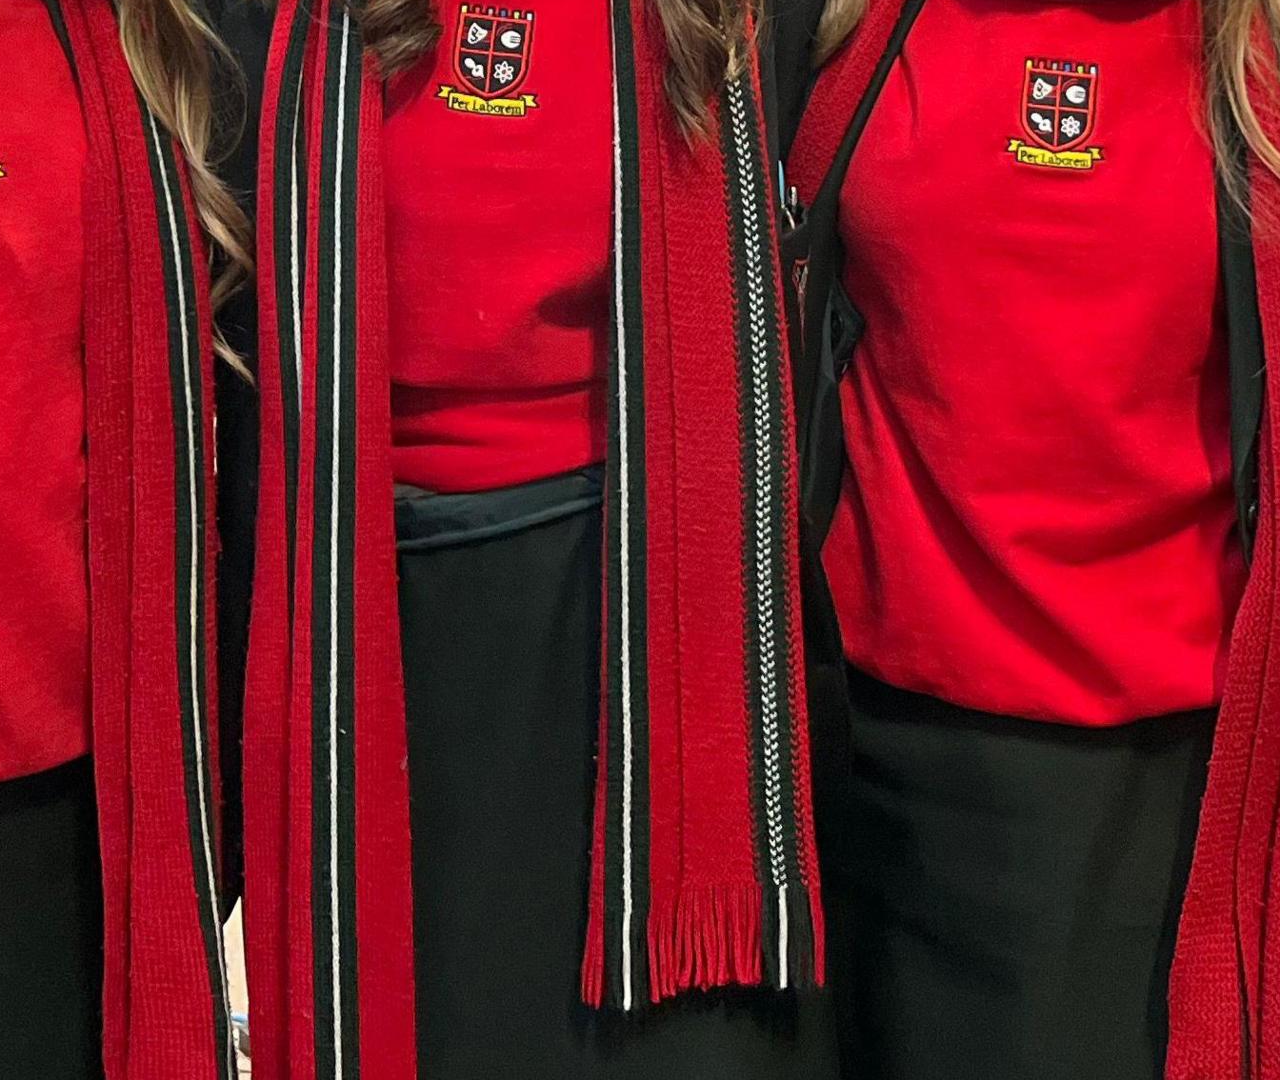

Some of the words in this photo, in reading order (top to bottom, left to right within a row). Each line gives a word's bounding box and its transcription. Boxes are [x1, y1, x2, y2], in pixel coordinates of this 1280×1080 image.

[452, 96, 470, 111] Per
[472, 99, 522, 115] Laborem
[1020, 149, 1038, 162] Per
[1041, 153, 1090, 167] Laborem
